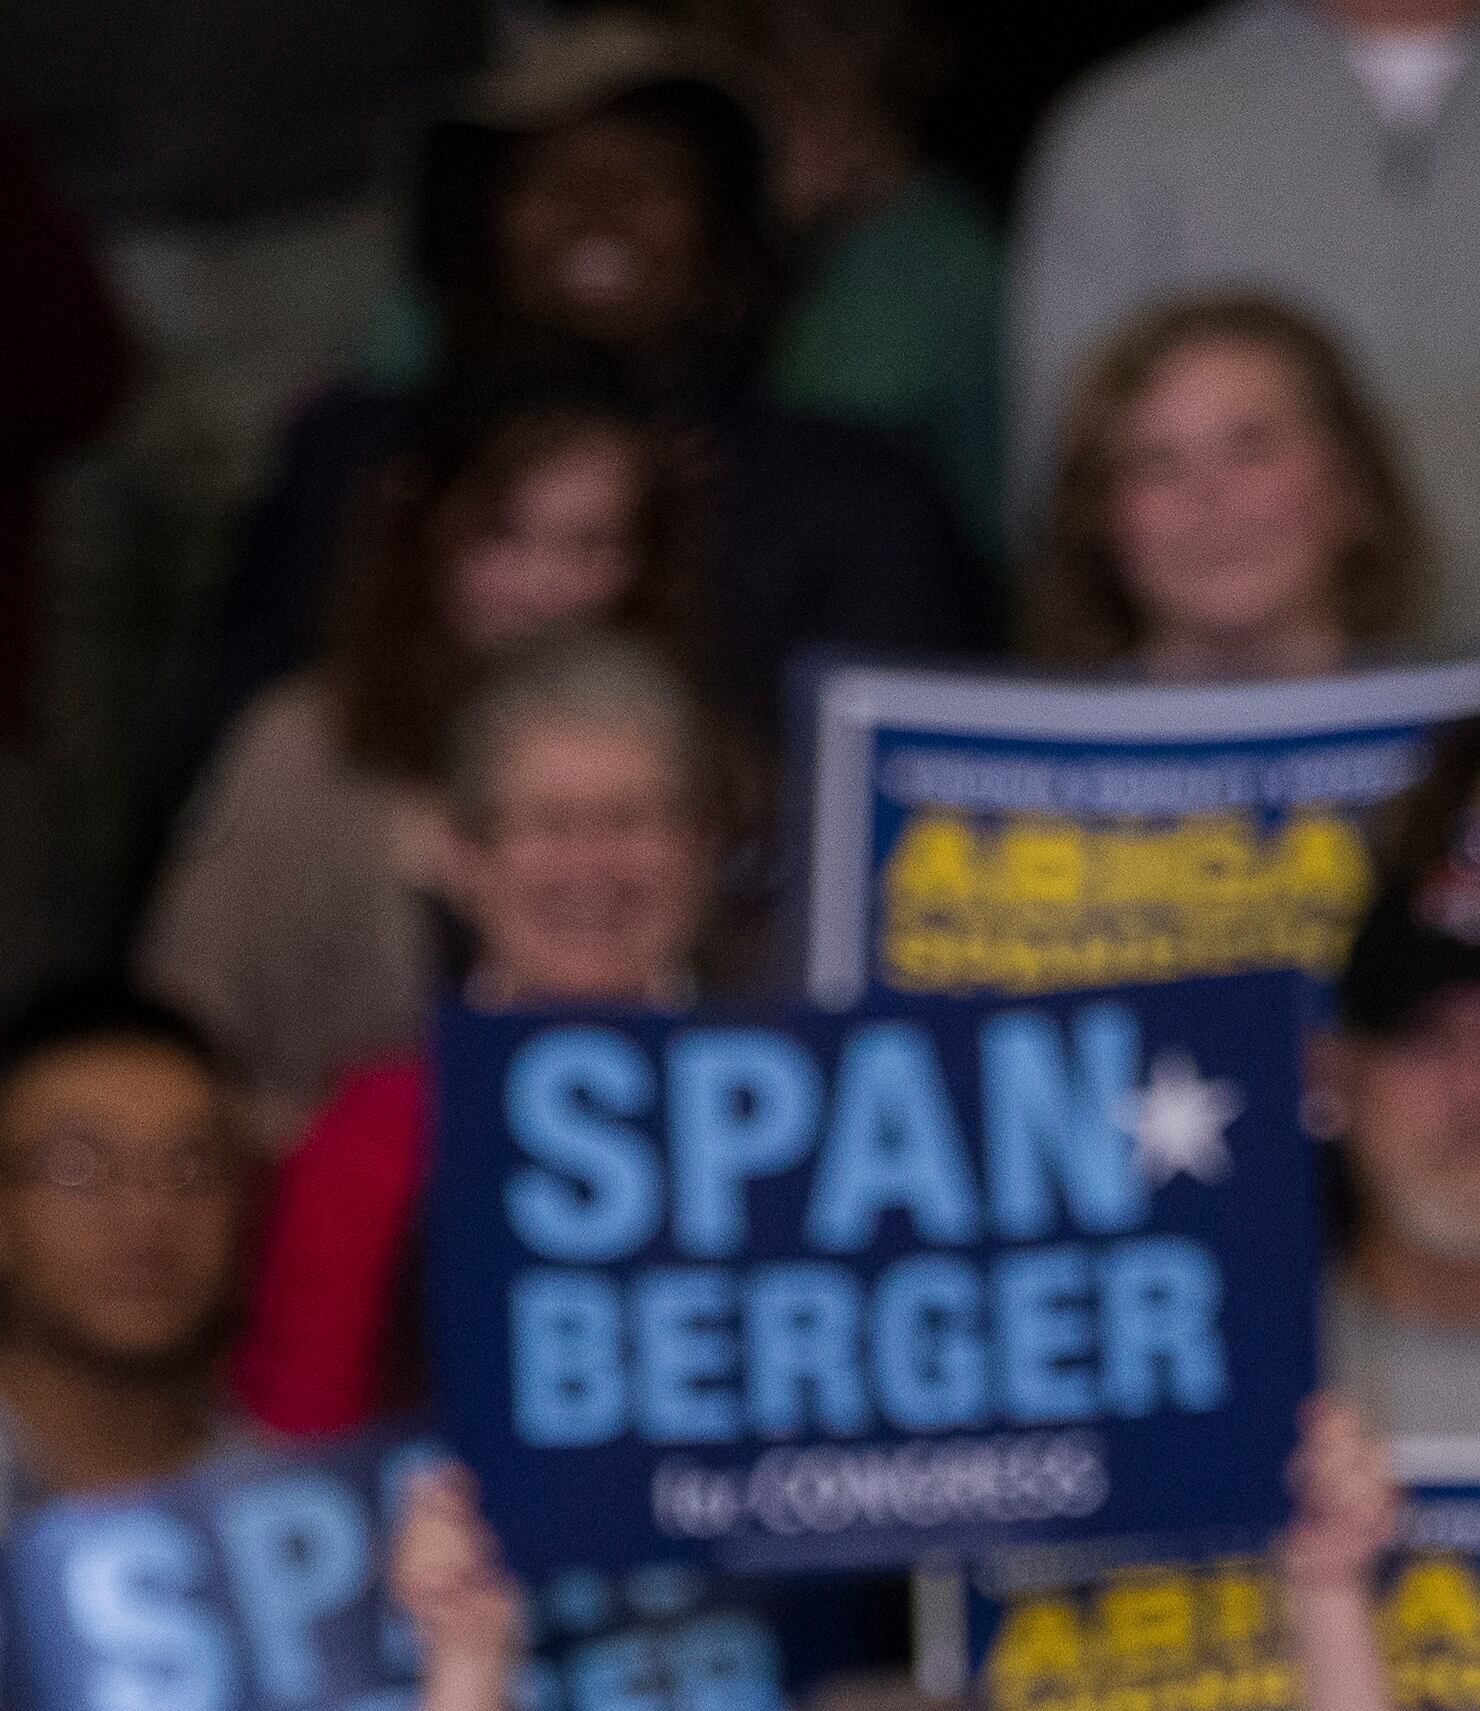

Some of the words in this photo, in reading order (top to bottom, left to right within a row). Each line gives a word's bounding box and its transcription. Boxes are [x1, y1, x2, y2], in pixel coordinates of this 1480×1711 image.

[500, 1012, 1138, 1260] SPAN
[506, 1238, 1230, 1450] BERGER
[746, 1430, 1107, 1535] CONGRESS
